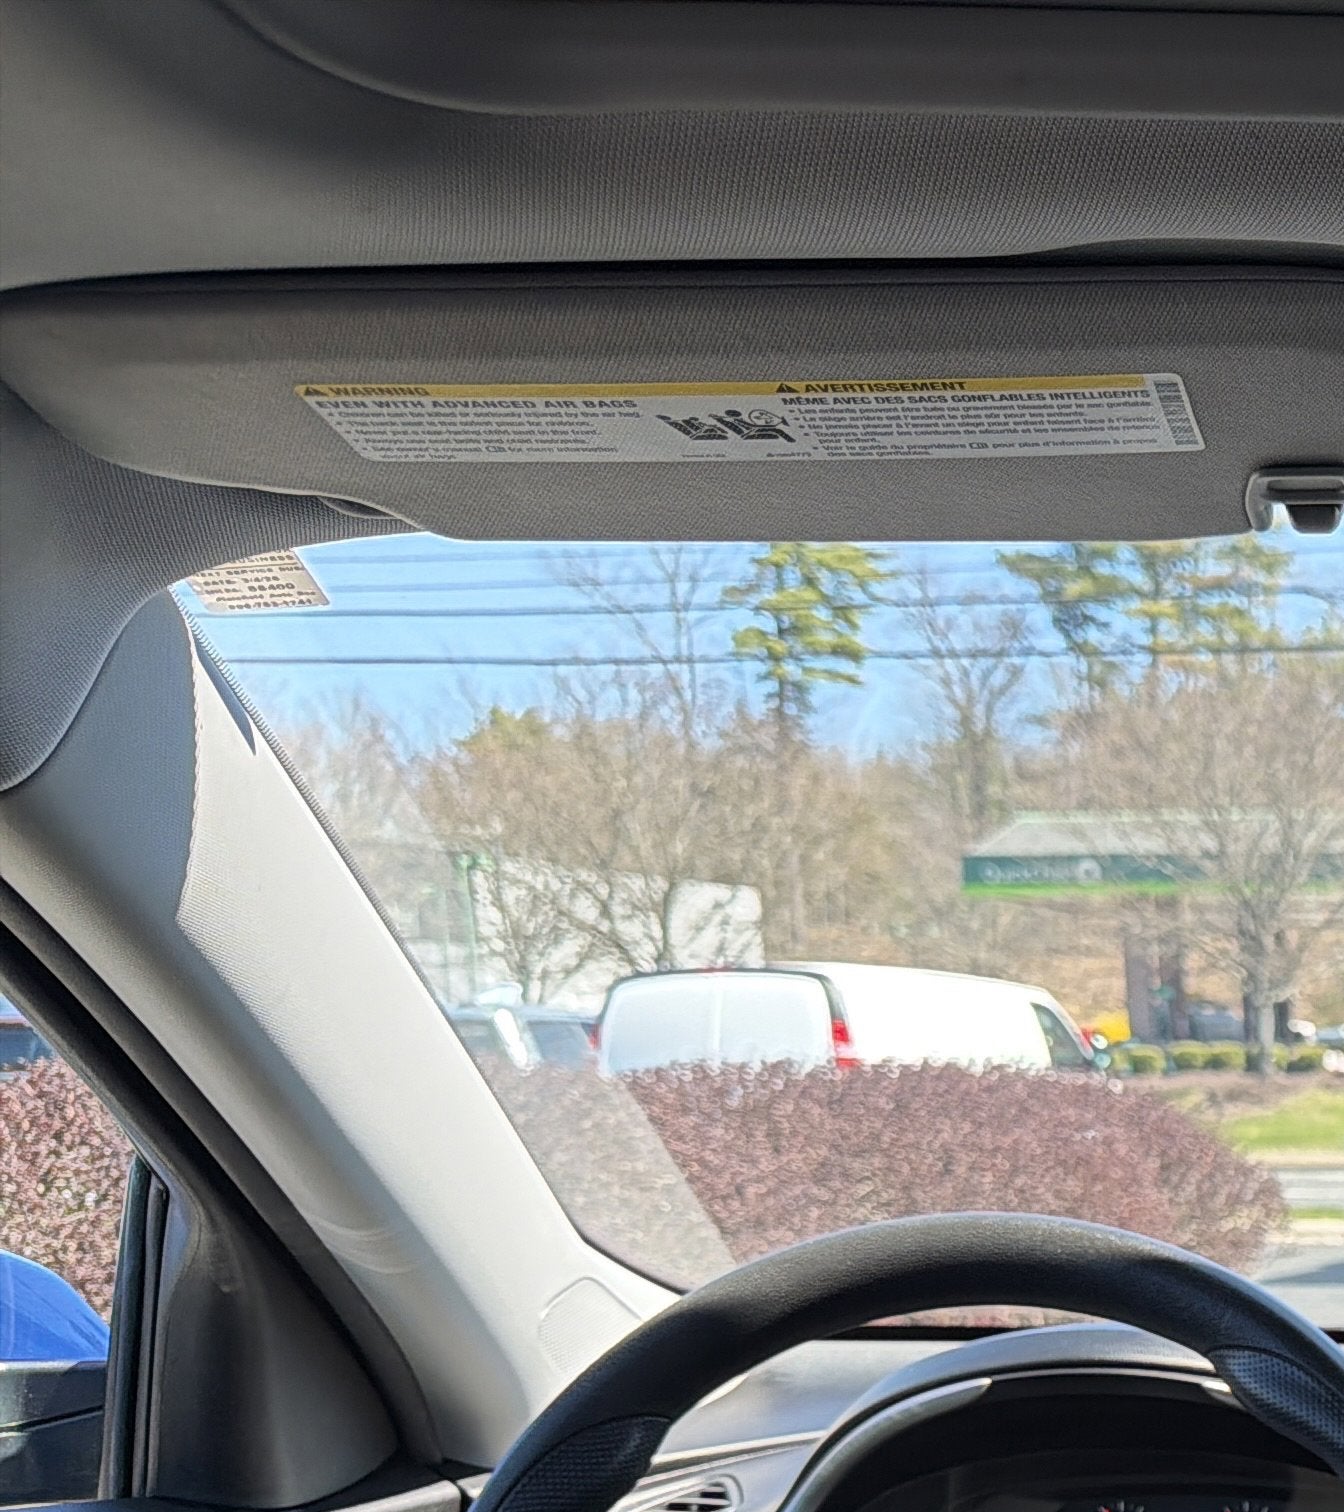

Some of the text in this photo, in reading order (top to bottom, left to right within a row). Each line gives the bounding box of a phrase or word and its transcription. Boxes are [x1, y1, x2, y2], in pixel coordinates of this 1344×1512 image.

[328, 386, 430, 397] WARNING
[804, 381, 967, 393] AVERTISSEMENT
[833, 396, 872, 405] AVEC
[874, 396, 905, 404] DES
[907, 395, 948, 404] SACS
[951, 393, 1047, 403] GONFLABLES
[1049, 390, 1151, 401] INTELLIGENTS
[315, 400, 637, 409] EVEN WITH ADVANCED AIR BAGS
